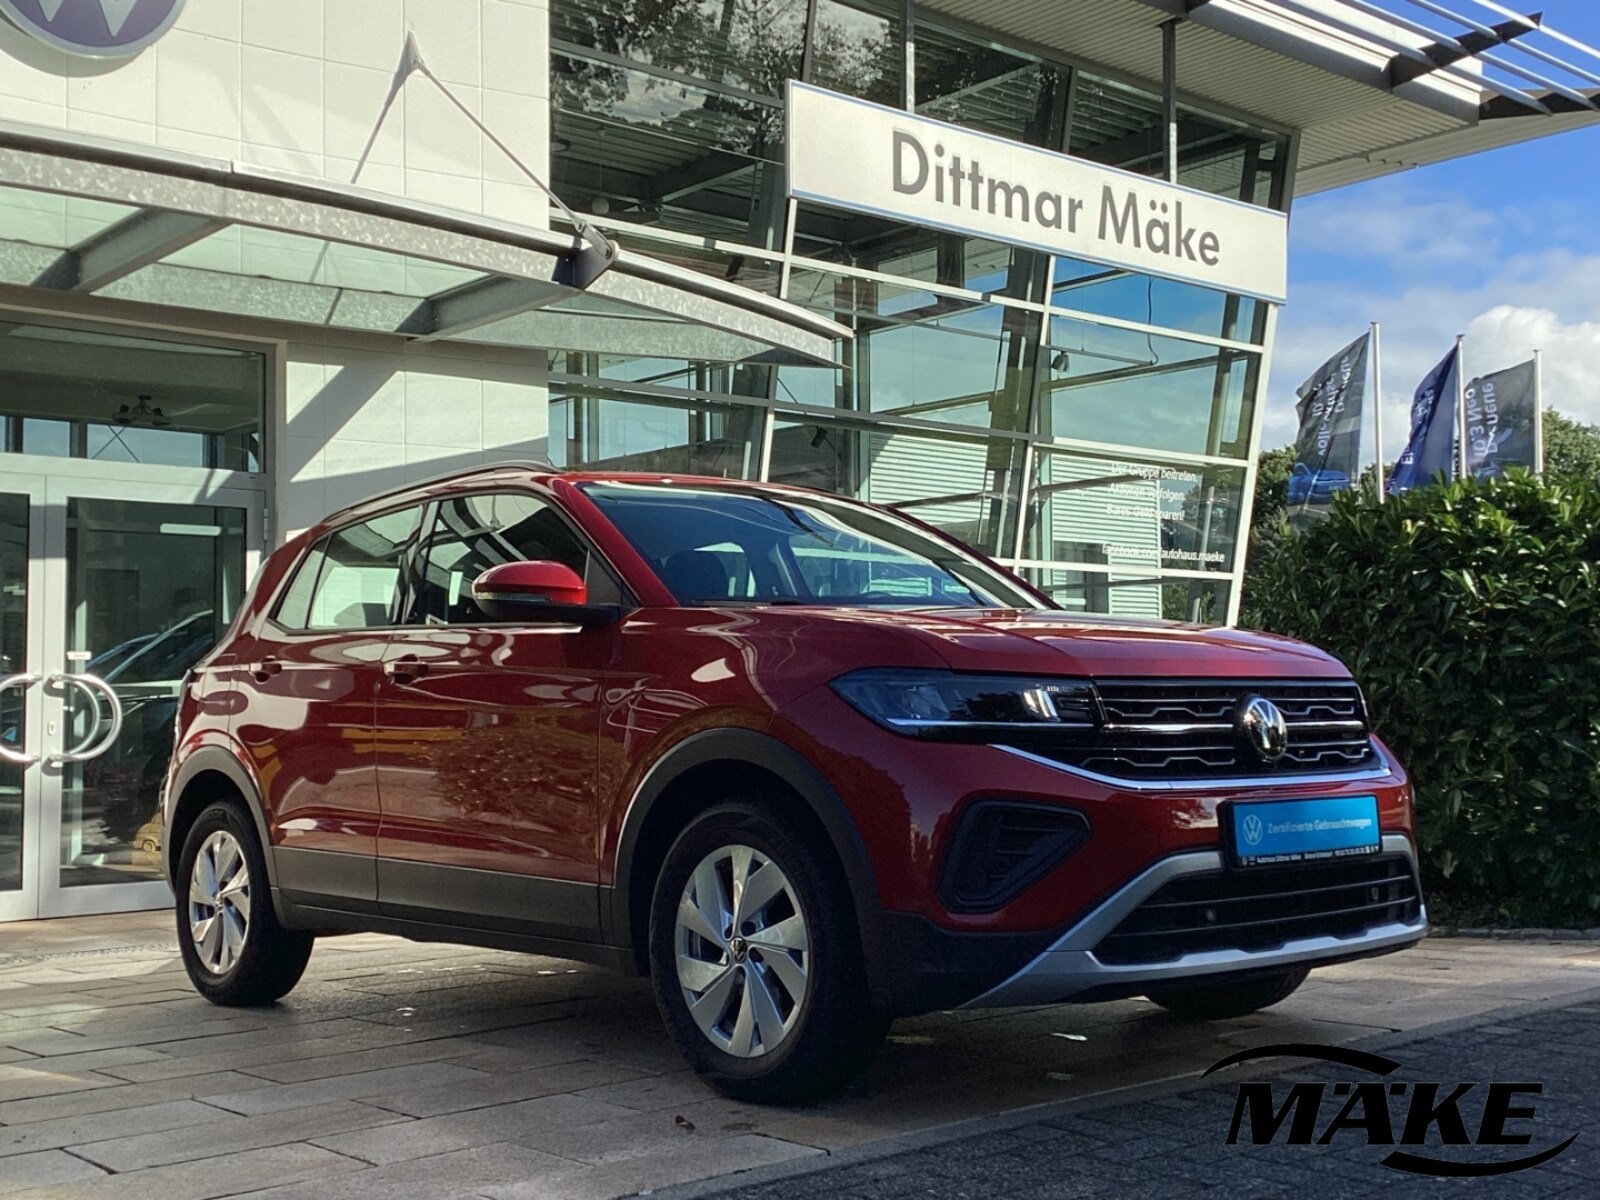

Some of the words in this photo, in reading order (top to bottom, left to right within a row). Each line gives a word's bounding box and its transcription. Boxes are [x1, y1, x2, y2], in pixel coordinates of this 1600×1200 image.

[892, 130, 1083, 234] Dittmar
[1097, 185, 1220, 267] Mäke
[1130, 465, 1159, 480] Gruppe
[1161, 467, 1198, 482] beitreten.
